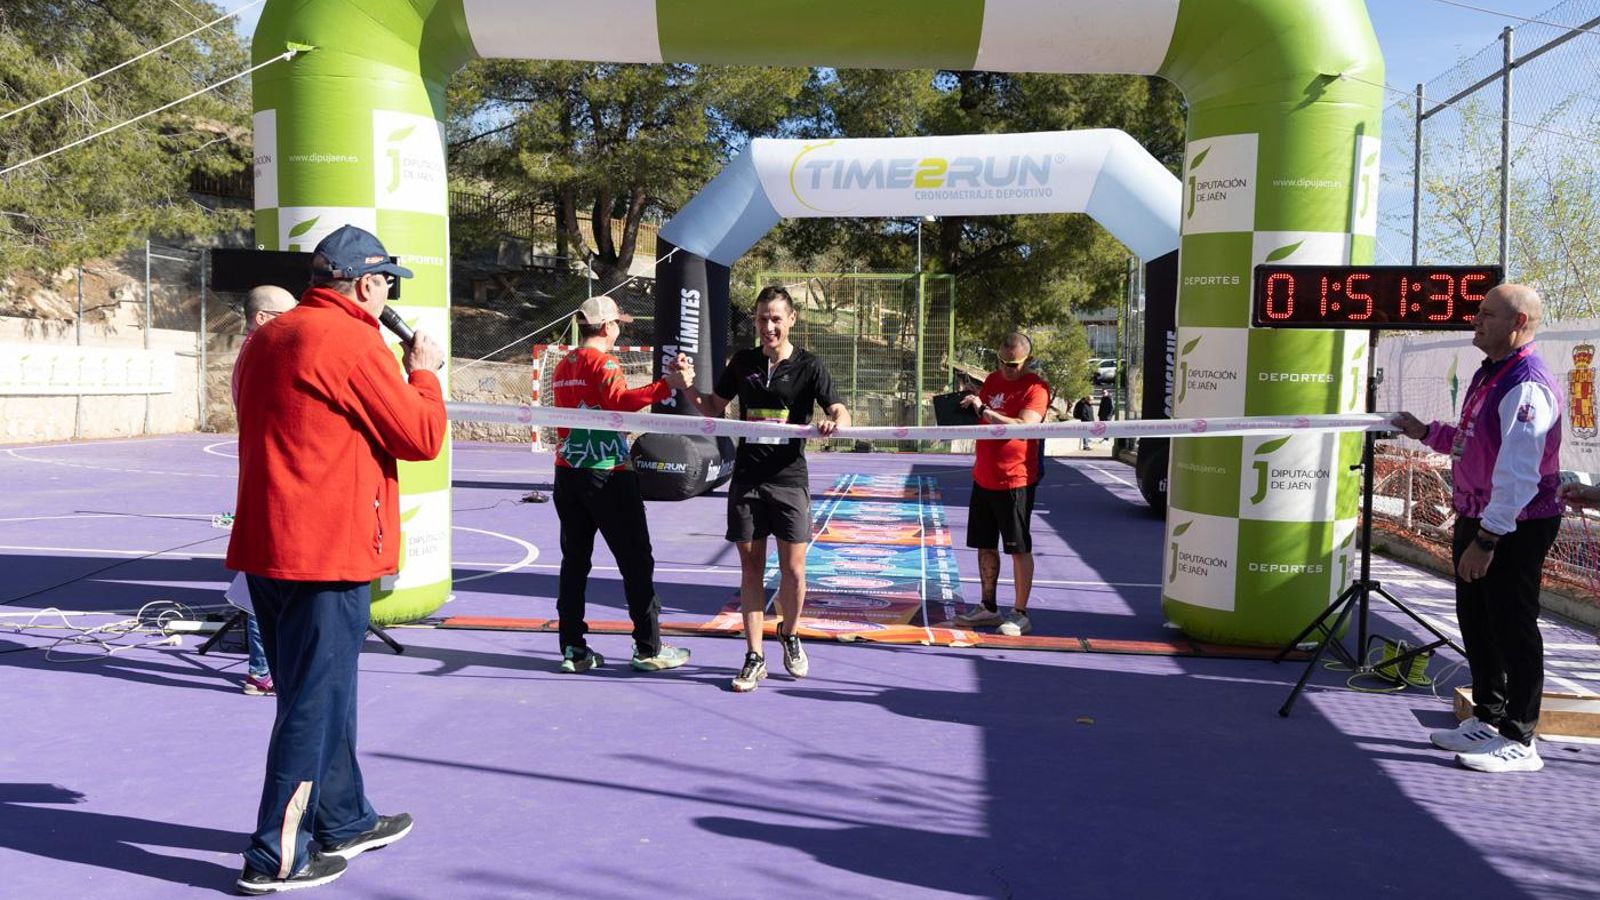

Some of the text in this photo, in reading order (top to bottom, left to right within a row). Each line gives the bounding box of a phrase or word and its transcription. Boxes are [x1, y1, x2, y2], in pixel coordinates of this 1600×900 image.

[288, 152, 359, 164] www.dipujaen.es
[1197, 178, 1247, 191] DIPUTACIÓN
[1272, 178, 1344, 189] www.dipujaen.es
[915, 187, 1053, 200] CRONOMETRAJE DEPORTIVO
[1206, 191, 1227, 201] JAÉN
[1184, 275, 1240, 286] DEPORTES
[675, 288, 701, 354] LÍMITES
[1188, 368, 1237, 381] DIPUTACIÓN
[1258, 372, 1334, 383] DEPORTES
[1198, 381, 1217, 391] JAÉN
[1271, 468, 1330, 479] DIPUTACIÓN
[1271, 480, 1312, 490] DE JAÉN
[1179, 551, 1228, 568] DIPUTACIÓN
[1190, 564, 1208, 577] JAÉN
[1248, 562, 1323, 573] DEPORTES
